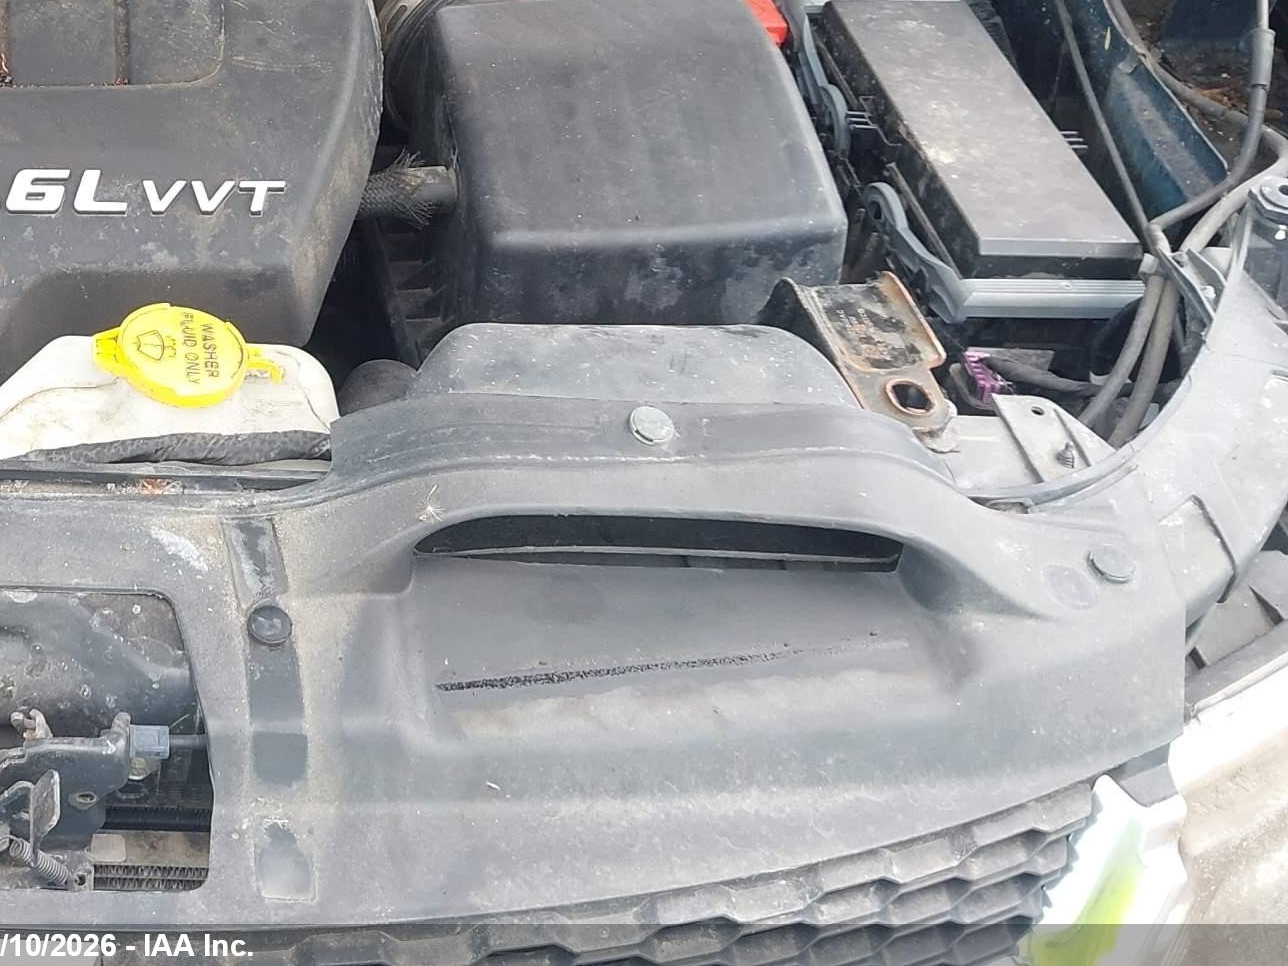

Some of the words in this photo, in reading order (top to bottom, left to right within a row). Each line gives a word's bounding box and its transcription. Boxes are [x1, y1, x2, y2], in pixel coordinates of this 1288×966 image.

[142, 179, 287, 217] VVT
[179, 312, 198, 347] FLUID
[184, 352, 201, 384] ONLY
[200, 324, 220, 377] WASHER
